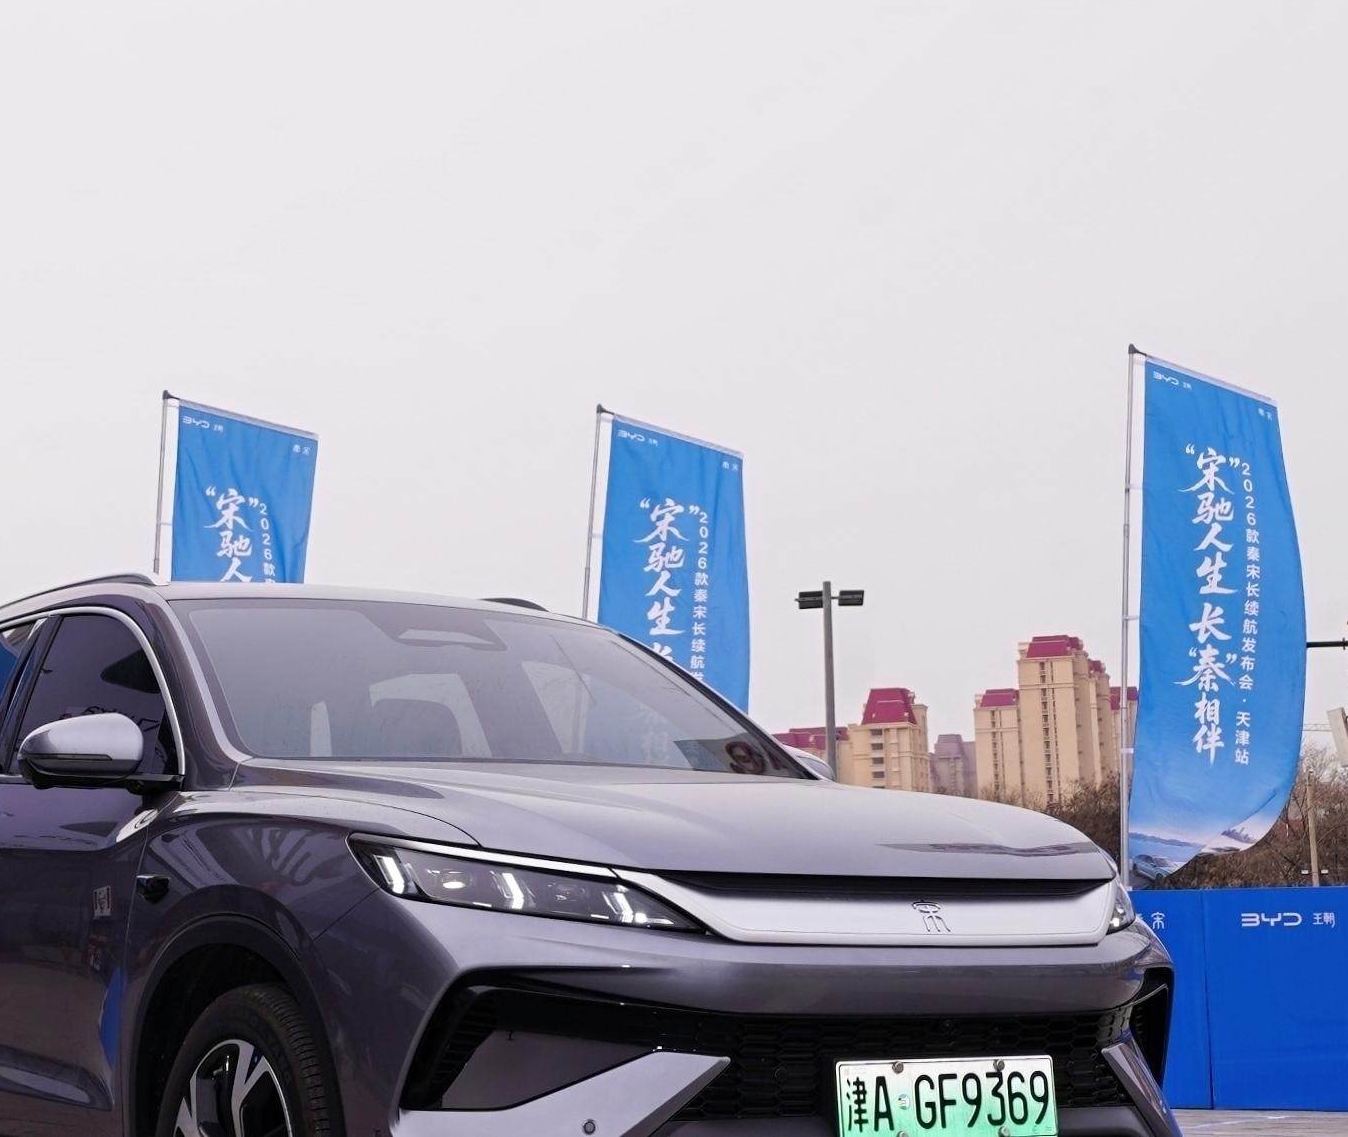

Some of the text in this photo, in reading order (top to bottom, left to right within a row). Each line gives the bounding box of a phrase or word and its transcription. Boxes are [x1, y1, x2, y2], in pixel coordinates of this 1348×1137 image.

[1153, 371, 1179, 386] BYD
[183, 416, 209, 429] BYD
[618, 429, 645, 442] BYD
[1241, 912, 1335, 928] BYD 王朝
[914, 1070, 1049, 1130] GF9369
